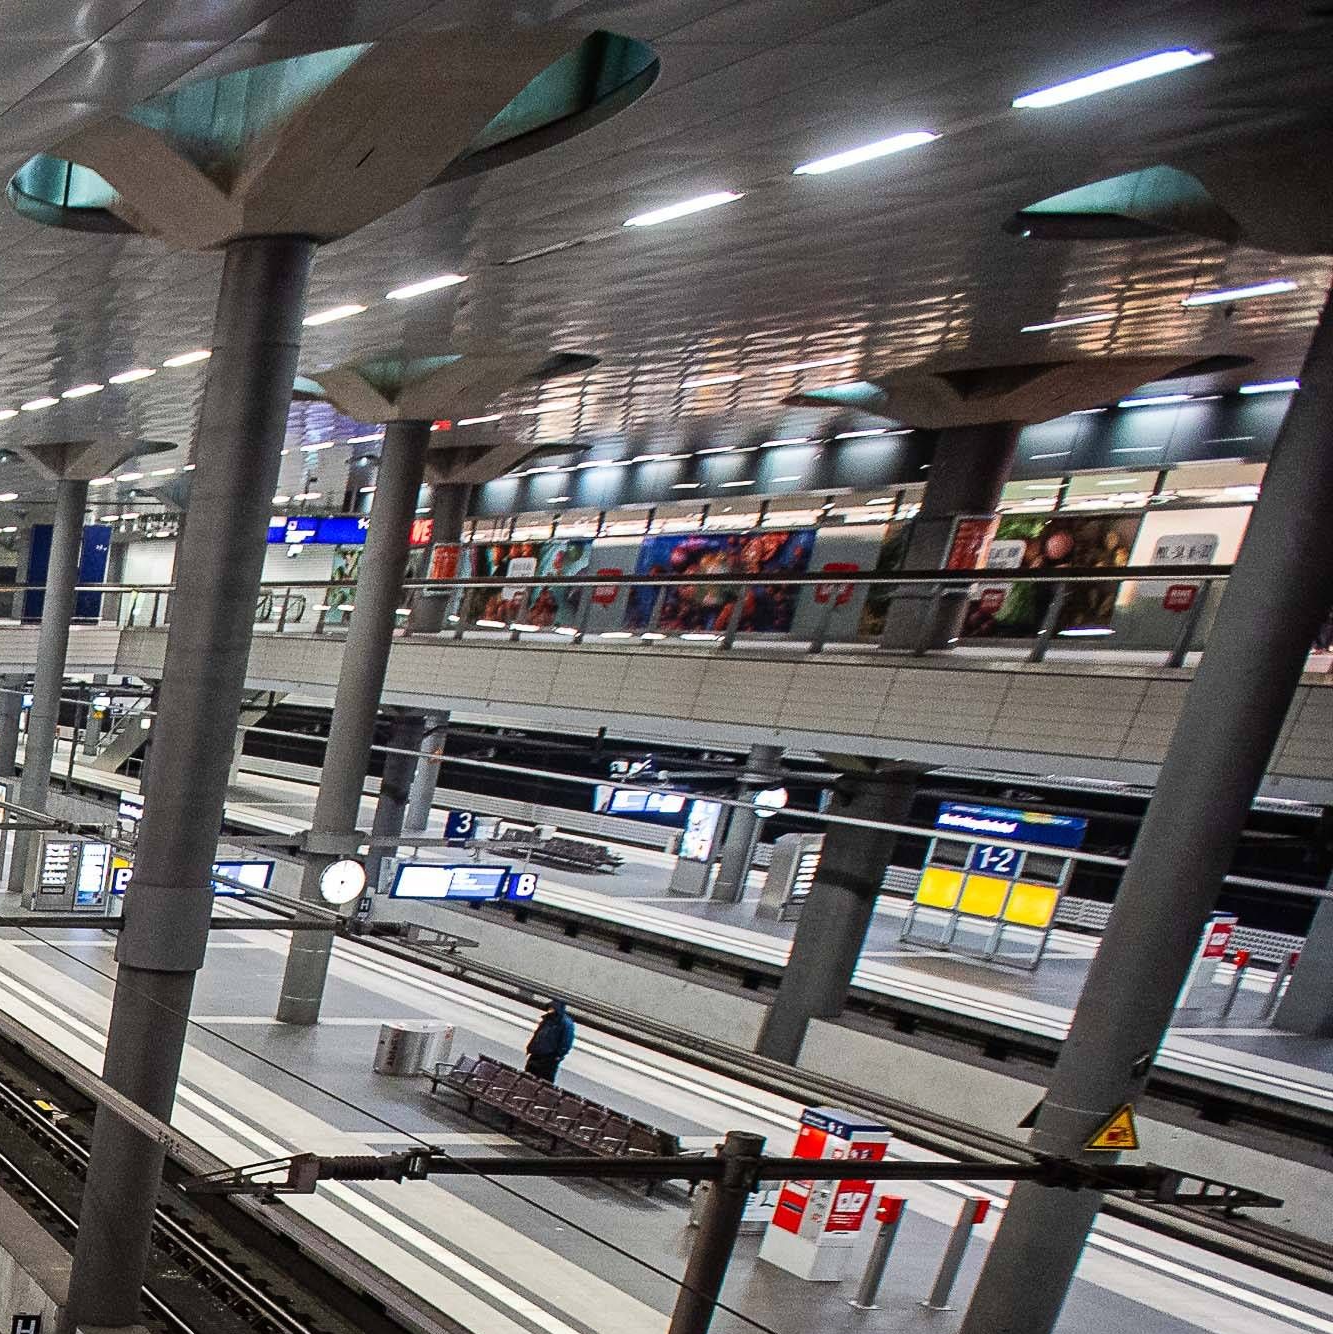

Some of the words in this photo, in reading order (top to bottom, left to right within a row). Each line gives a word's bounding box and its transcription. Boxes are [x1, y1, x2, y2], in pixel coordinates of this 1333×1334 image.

[412, 519, 435, 543] WE
[456, 813, 472, 834] 3
[979, 846, 1016, 873] 1-2
[515, 873, 536, 897] B
